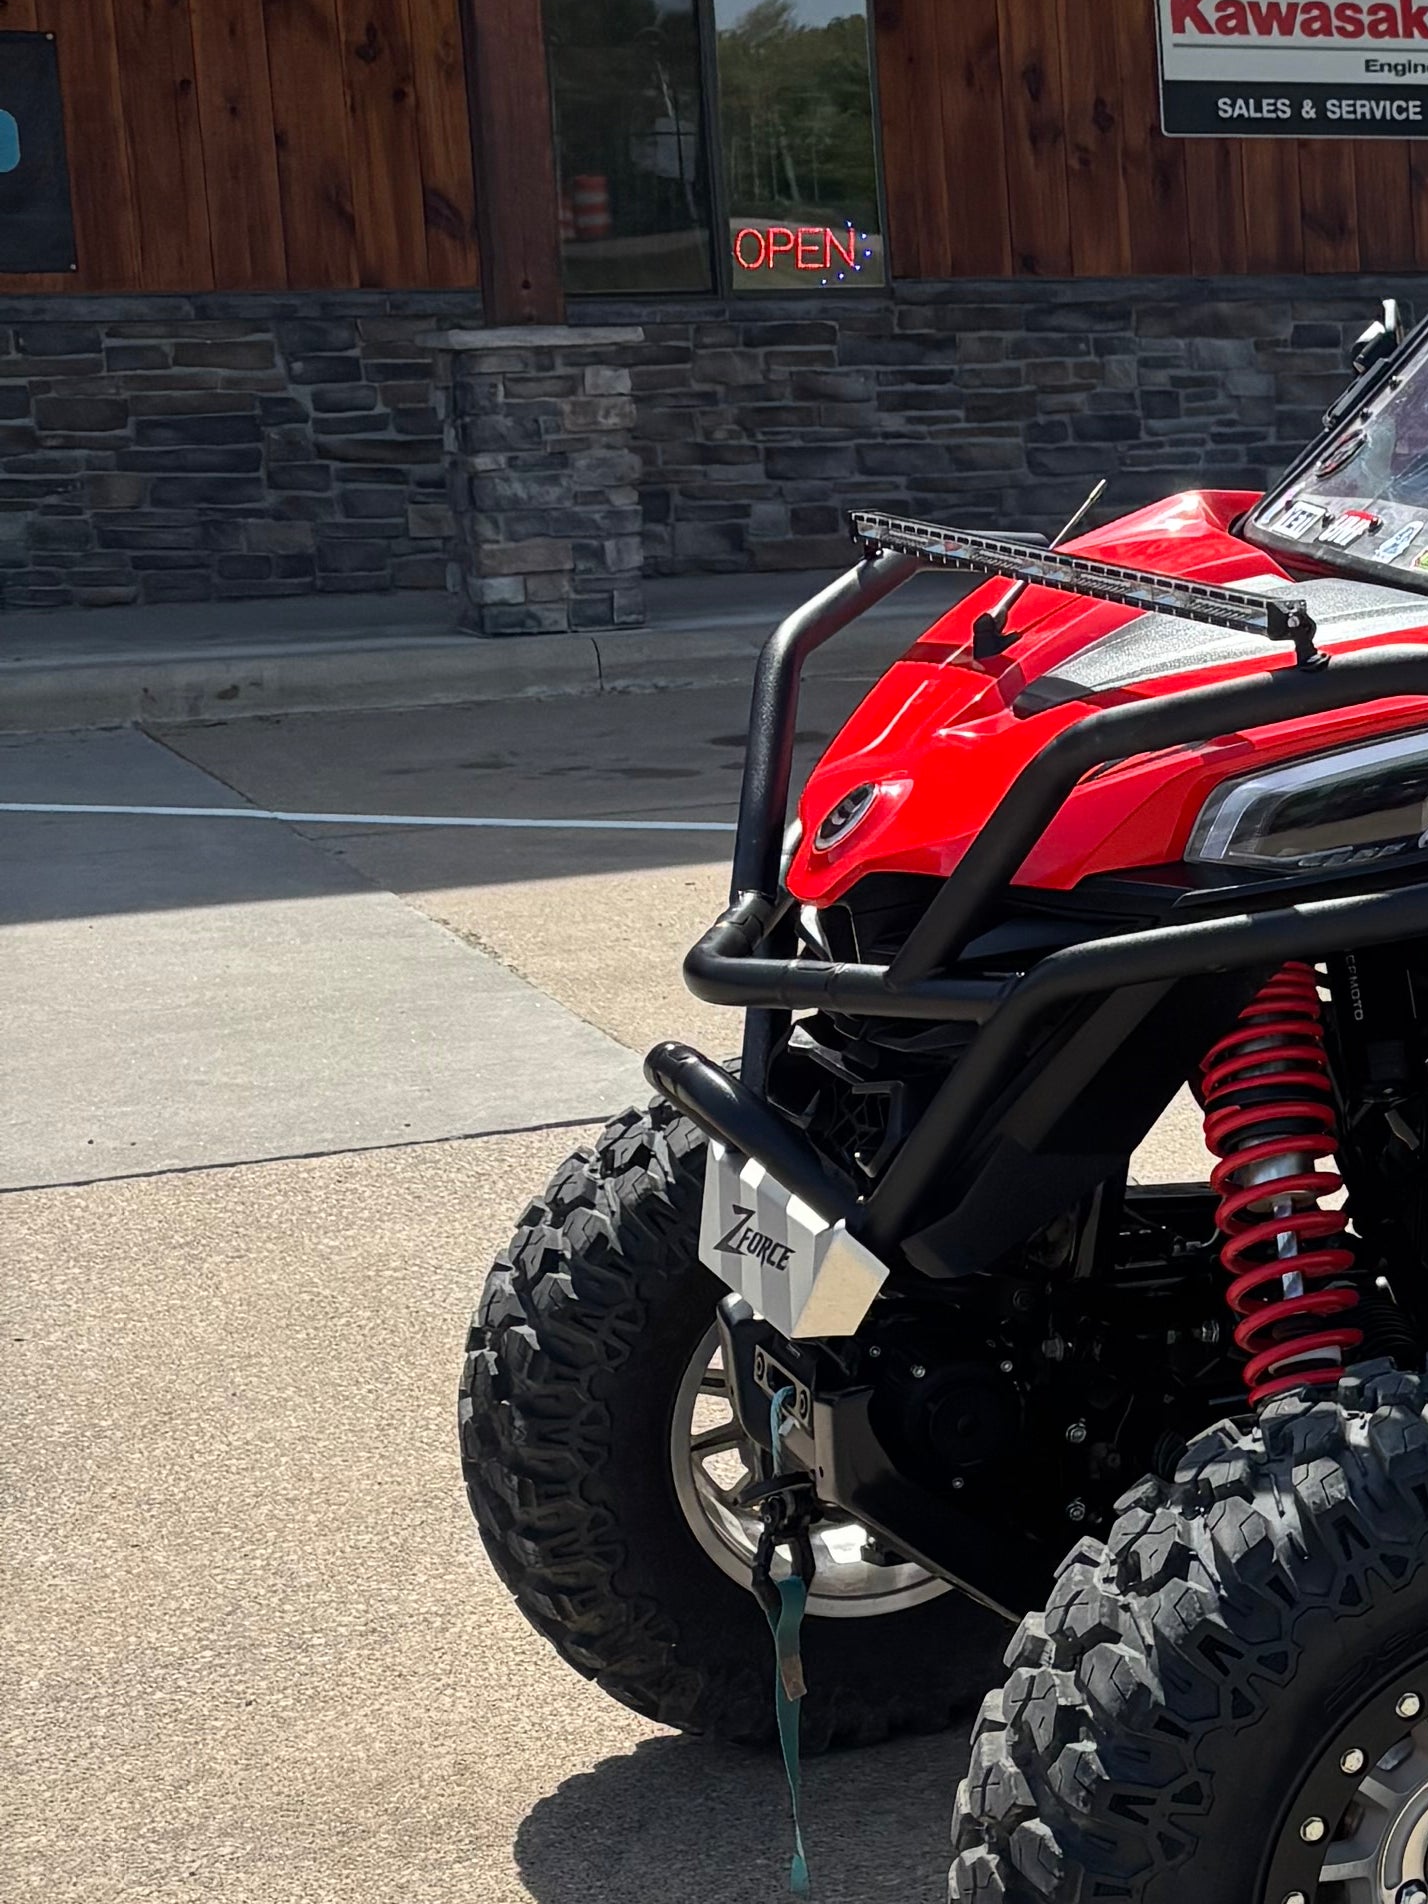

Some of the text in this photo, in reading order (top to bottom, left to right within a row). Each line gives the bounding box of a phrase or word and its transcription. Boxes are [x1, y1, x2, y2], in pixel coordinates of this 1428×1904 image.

[1217, 97, 1423, 121] SALES & SERVICE
[733, 226, 857, 271] OPEN
[1280, 508, 1318, 534] YETI
[712, 1203, 797, 1272] ZFORCE
